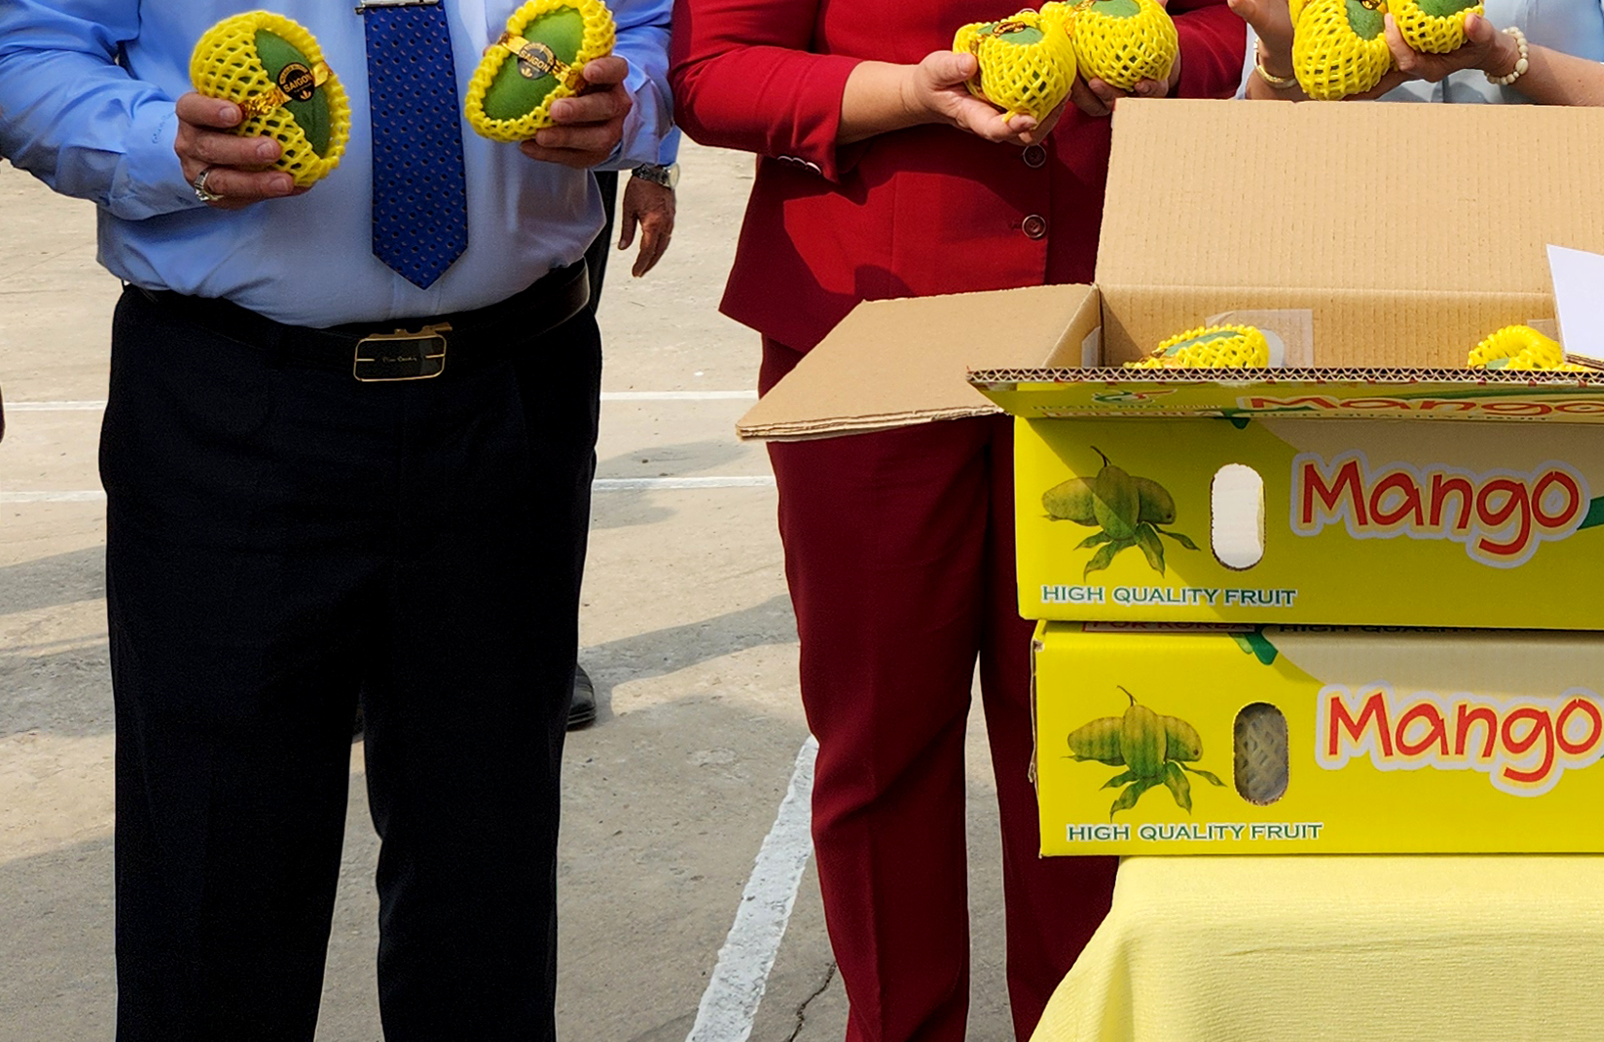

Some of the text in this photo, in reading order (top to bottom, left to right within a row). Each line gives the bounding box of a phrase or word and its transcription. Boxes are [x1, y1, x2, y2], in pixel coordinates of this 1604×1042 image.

[519, 49, 552, 74] SAIGON
[282, 73, 314, 94] SAIGON
[1302, 459, 1580, 555] Mango
[1042, 585, 1297, 606] HIGH QUALITY FRUIT
[1329, 692, 1603, 783] Mango
[1068, 823, 1323, 841] HIGH QUALITY FRUIT
